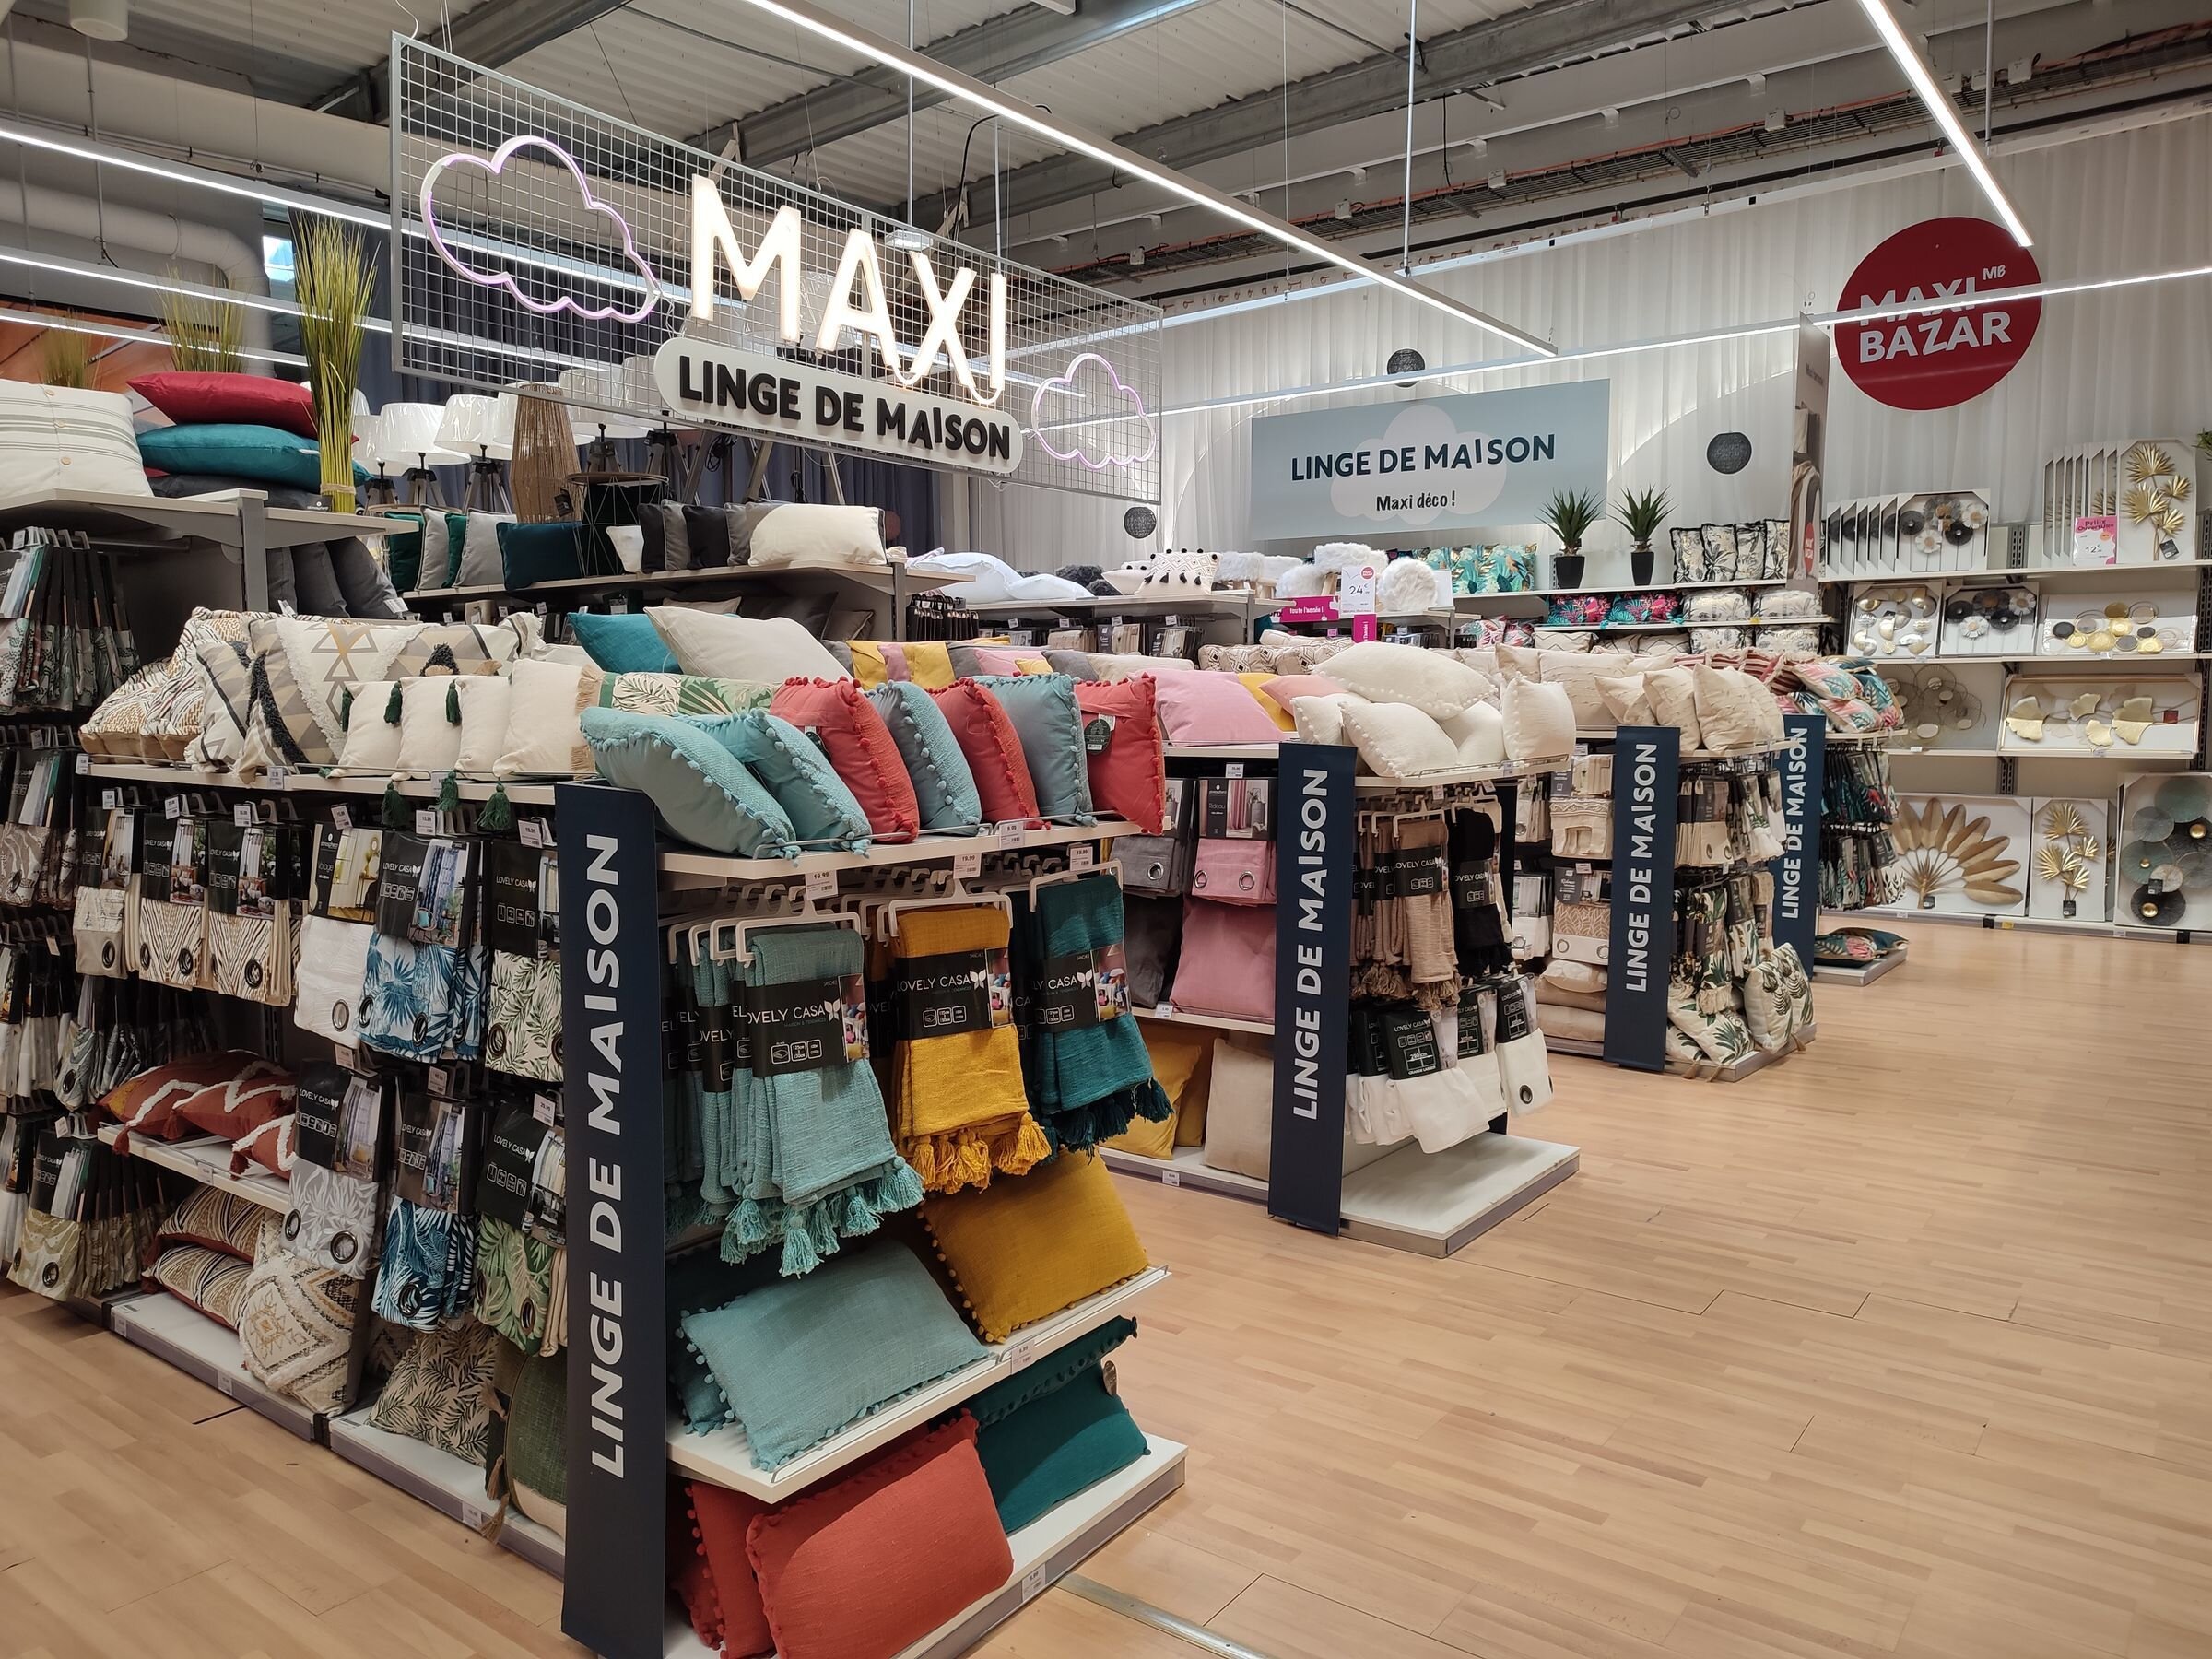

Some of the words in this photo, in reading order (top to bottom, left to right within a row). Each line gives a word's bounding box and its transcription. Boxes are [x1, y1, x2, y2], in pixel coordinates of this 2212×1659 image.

[690, 172, 1008, 393] MAXI
[1983, 265, 2006, 280] MB
[1859, 276, 1976, 326] MAXI
[1859, 311, 2012, 364] BAZAR
[679, 355, 801, 421] LINGE
[816, 385, 864, 432] DE
[877, 397, 1010, 460] MAISON
[1291, 450, 1371, 481] LINGE
[1379, 446, 1416, 475] DE
[1424, 433, 1555, 471] MAISON
[1376, 493, 1413, 512] Maxi
[1416, 491, 1448, 509] déco
[1786, 727, 1808, 817] MAISON
[1630, 743, 1658, 859] MAISON
[1298, 769, 1330, 933] MAISON
[1785, 823, 1804, 851] DE
[496, 876, 514, 885] LOVELY
[515, 877, 529, 888] CASA
[1629, 867, 1652, 904] DE
[1782, 856, 1802, 920] LINGE
[1296, 945, 1324, 996] DE
[1626, 911, 1651, 993] LINGE
[584, 833, 623, 1135] MAISON
[897, 977, 935, 992] LOVELY
[939, 974, 971, 989] CASA
[1048, 977, 1078, 990] CASA
[700, 1029, 734, 1043] VELY
[747, 1008, 789, 1025] VELY
[793, 1004, 826, 1019] CASA
[1394, 1024, 1412, 1032] LOVELY
[1292, 1006, 1321, 1120] LINGE
[299, 1088, 318, 1101] LOVELY
[494, 1135, 512, 1148] LOVELY
[589, 1158, 623, 1253] DE
[590, 1272, 625, 1478] LINGE
